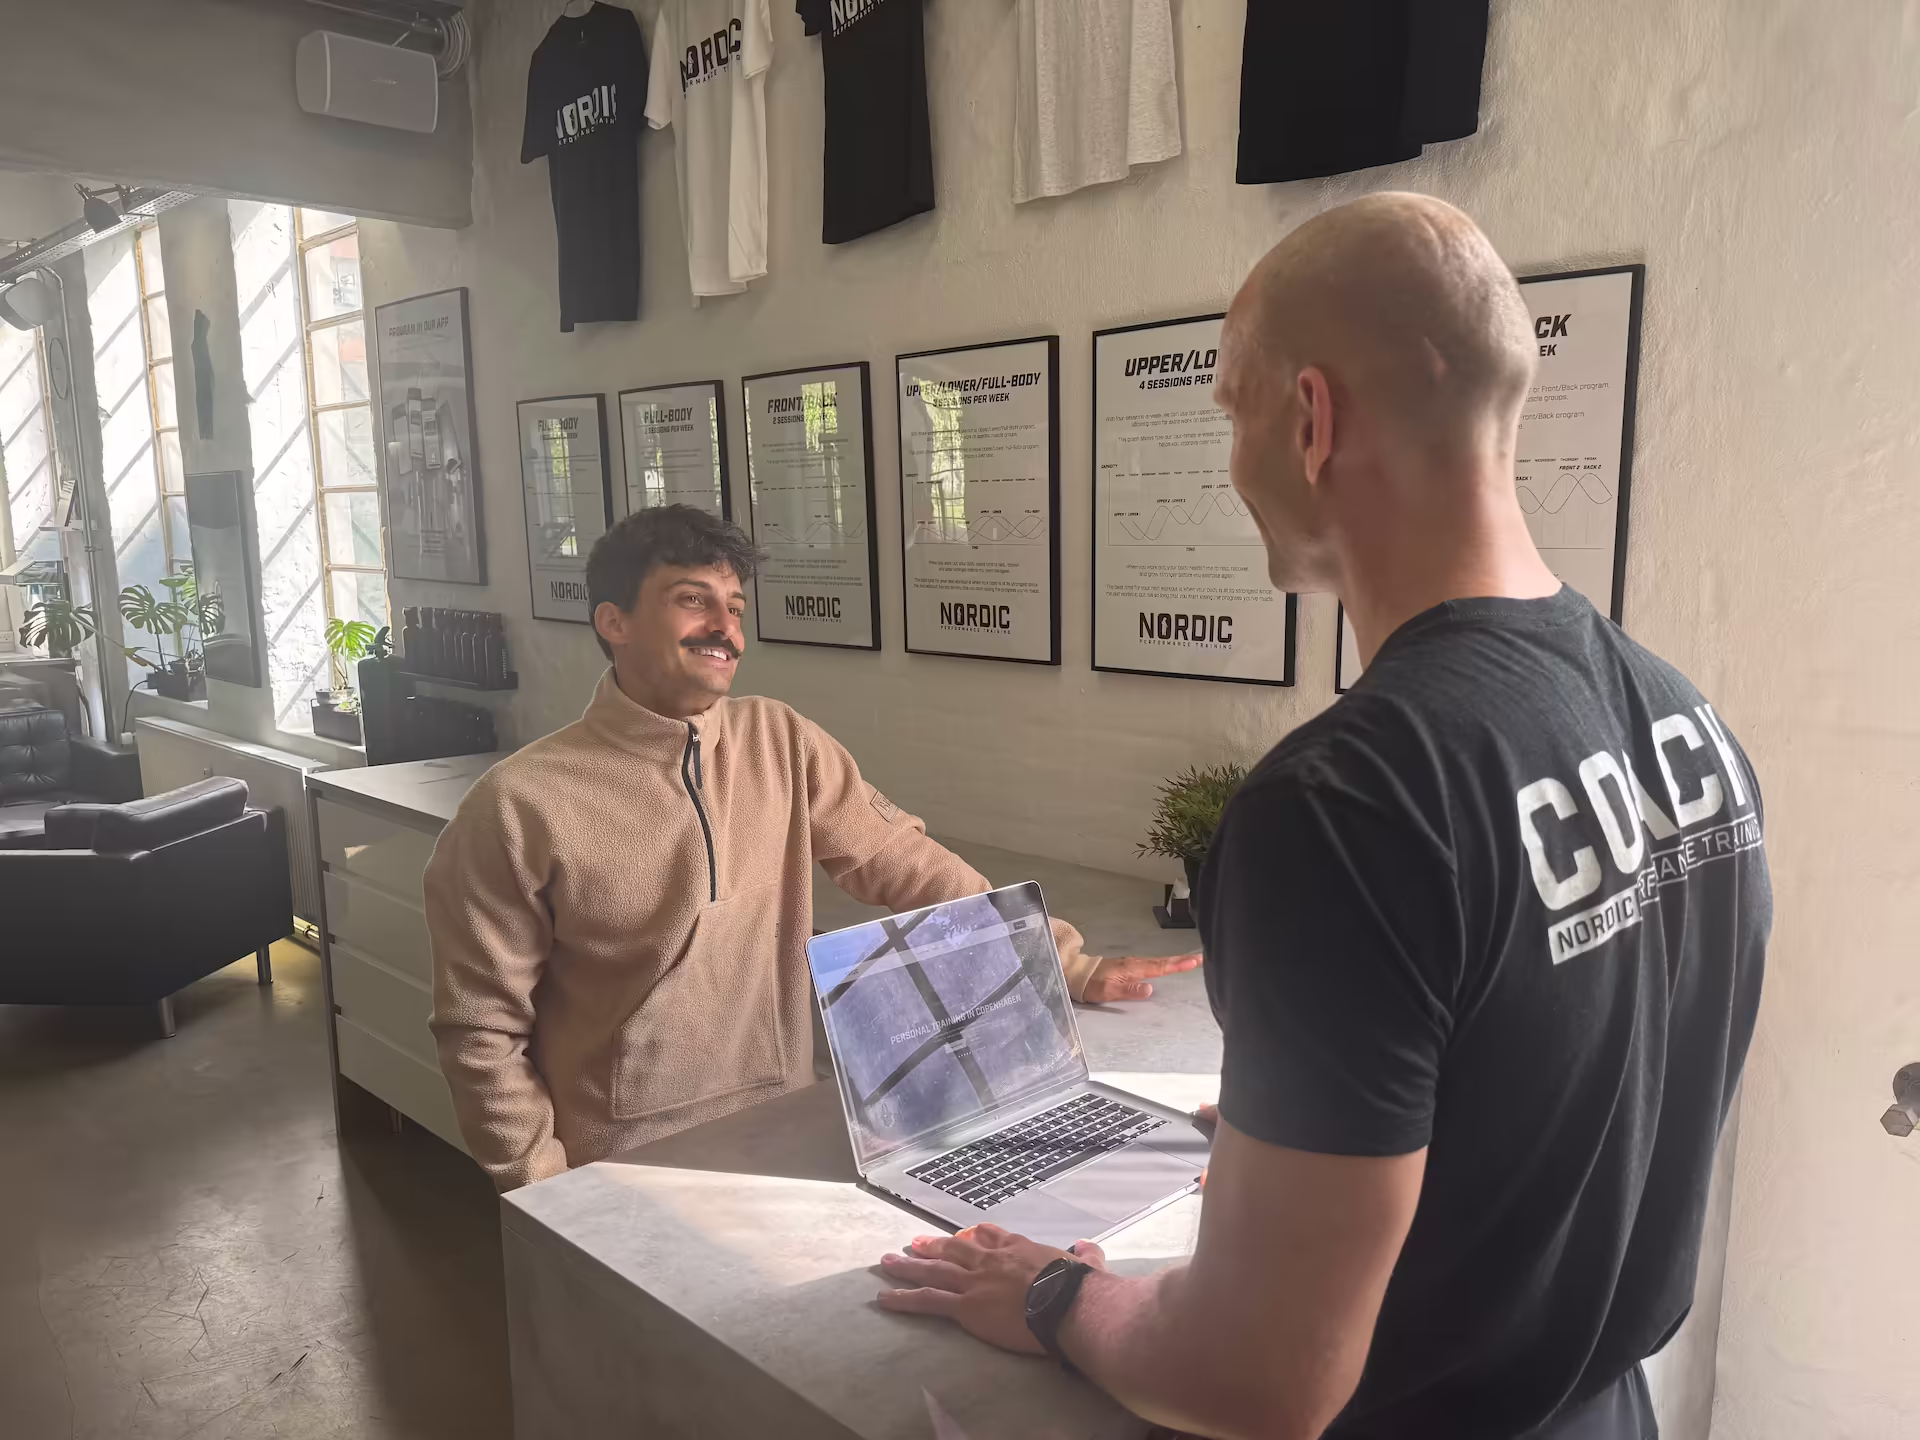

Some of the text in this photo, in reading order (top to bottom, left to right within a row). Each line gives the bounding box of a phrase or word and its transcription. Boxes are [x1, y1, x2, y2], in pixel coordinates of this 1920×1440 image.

[680, 18, 742, 93] NORDC
[1535, 314, 1572, 339] CK
[1539, 344, 1557, 357] EK
[1125, 349, 1219, 377] UPPER/LO
[1139, 374, 1214, 390] 4 SESSIONS PER
[973, 394, 988, 405] PER
[988, 392, 1011, 402] WEEK
[1525, 395, 1543, 403] uscle
[644, 406, 693, 425] FULL-BODY
[777, 414, 805, 425] SESSIONS
[1520, 412, 1555, 421] ront/Back
[785, 595, 841, 619] NORDIC
[940, 602, 1010, 629] NORDIC
[1139, 612, 1233, 643] NORDIC
[1557, 895, 1635, 953] NORDIC
[890, 1025, 931, 1045] PERSONAL
[931, 1012, 966, 1031] TRAINING
[966, 1009, 976, 1020] IN
[976, 994, 1022, 1016] COPENHAGEN
